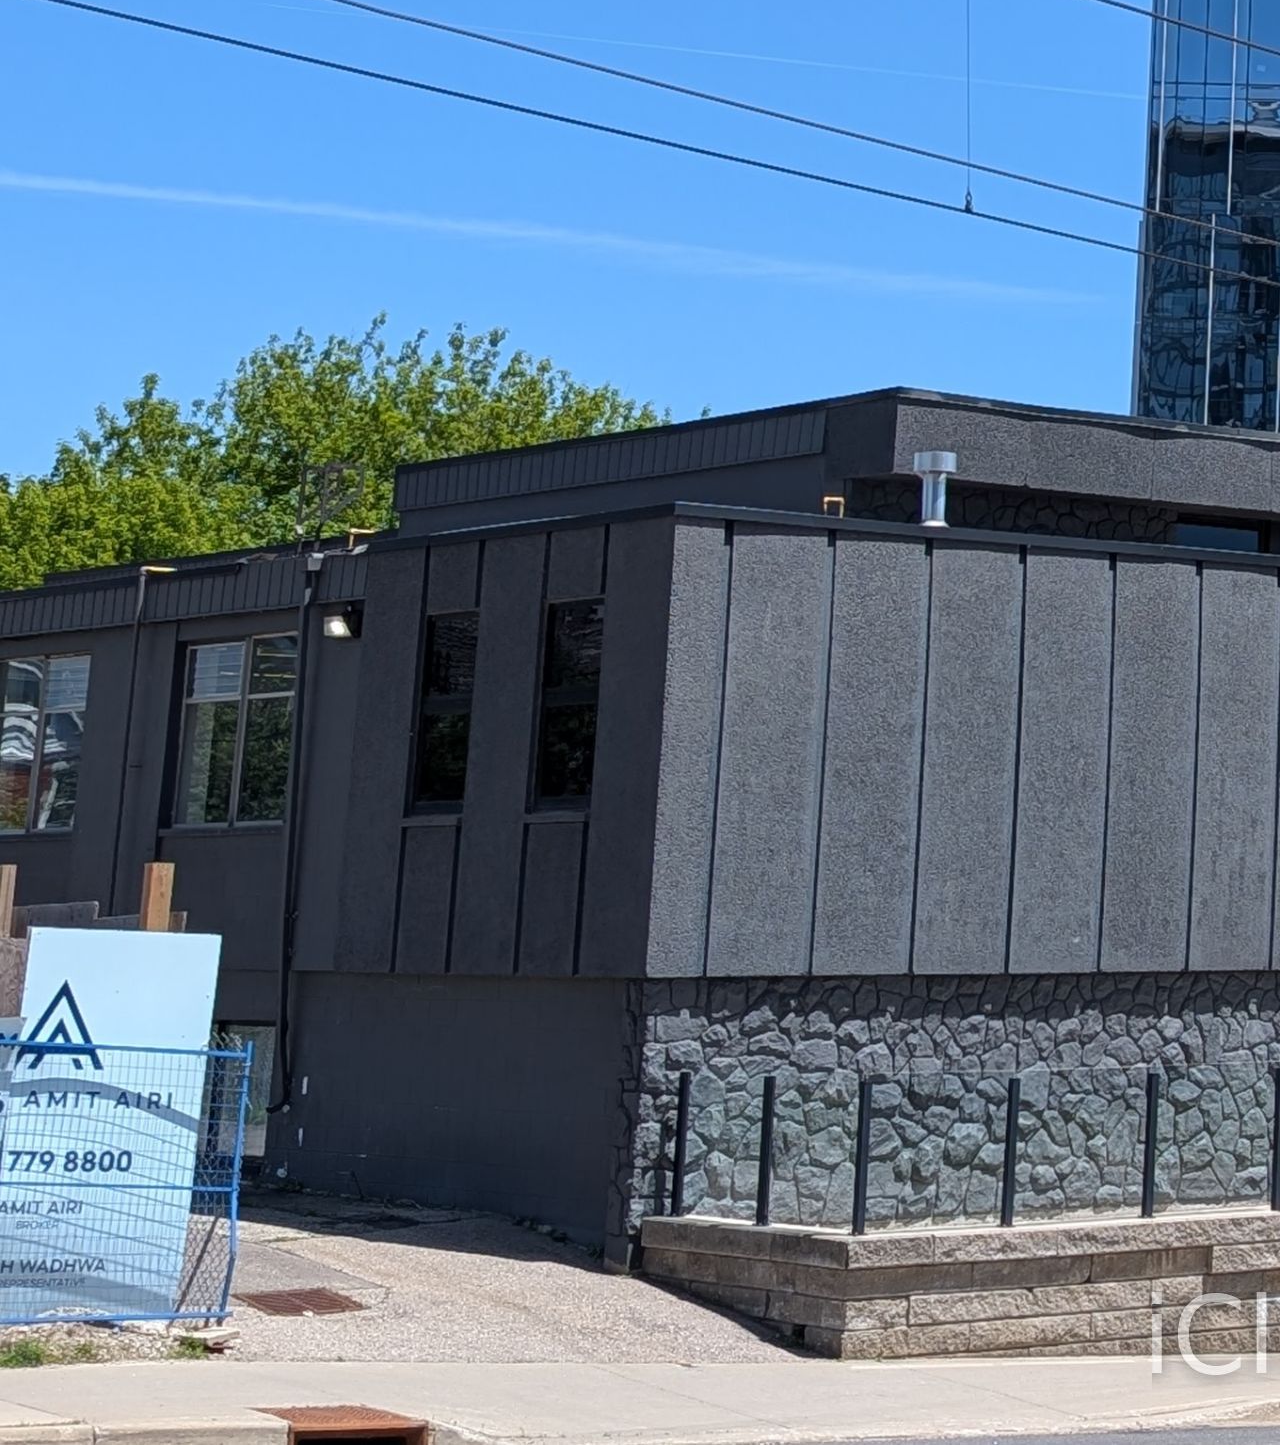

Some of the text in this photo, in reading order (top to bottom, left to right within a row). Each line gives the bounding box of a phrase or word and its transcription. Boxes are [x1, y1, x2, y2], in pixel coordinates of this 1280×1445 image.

[22, 1090, 101, 1109] AMIT
[113, 1090, 174, 1110] AIRI
[7, 1150, 133, 1173] 779 8800
[0, 1200, 84, 1215] AMIT AIRI
[19, 1258, 106, 1274] WADHWA
